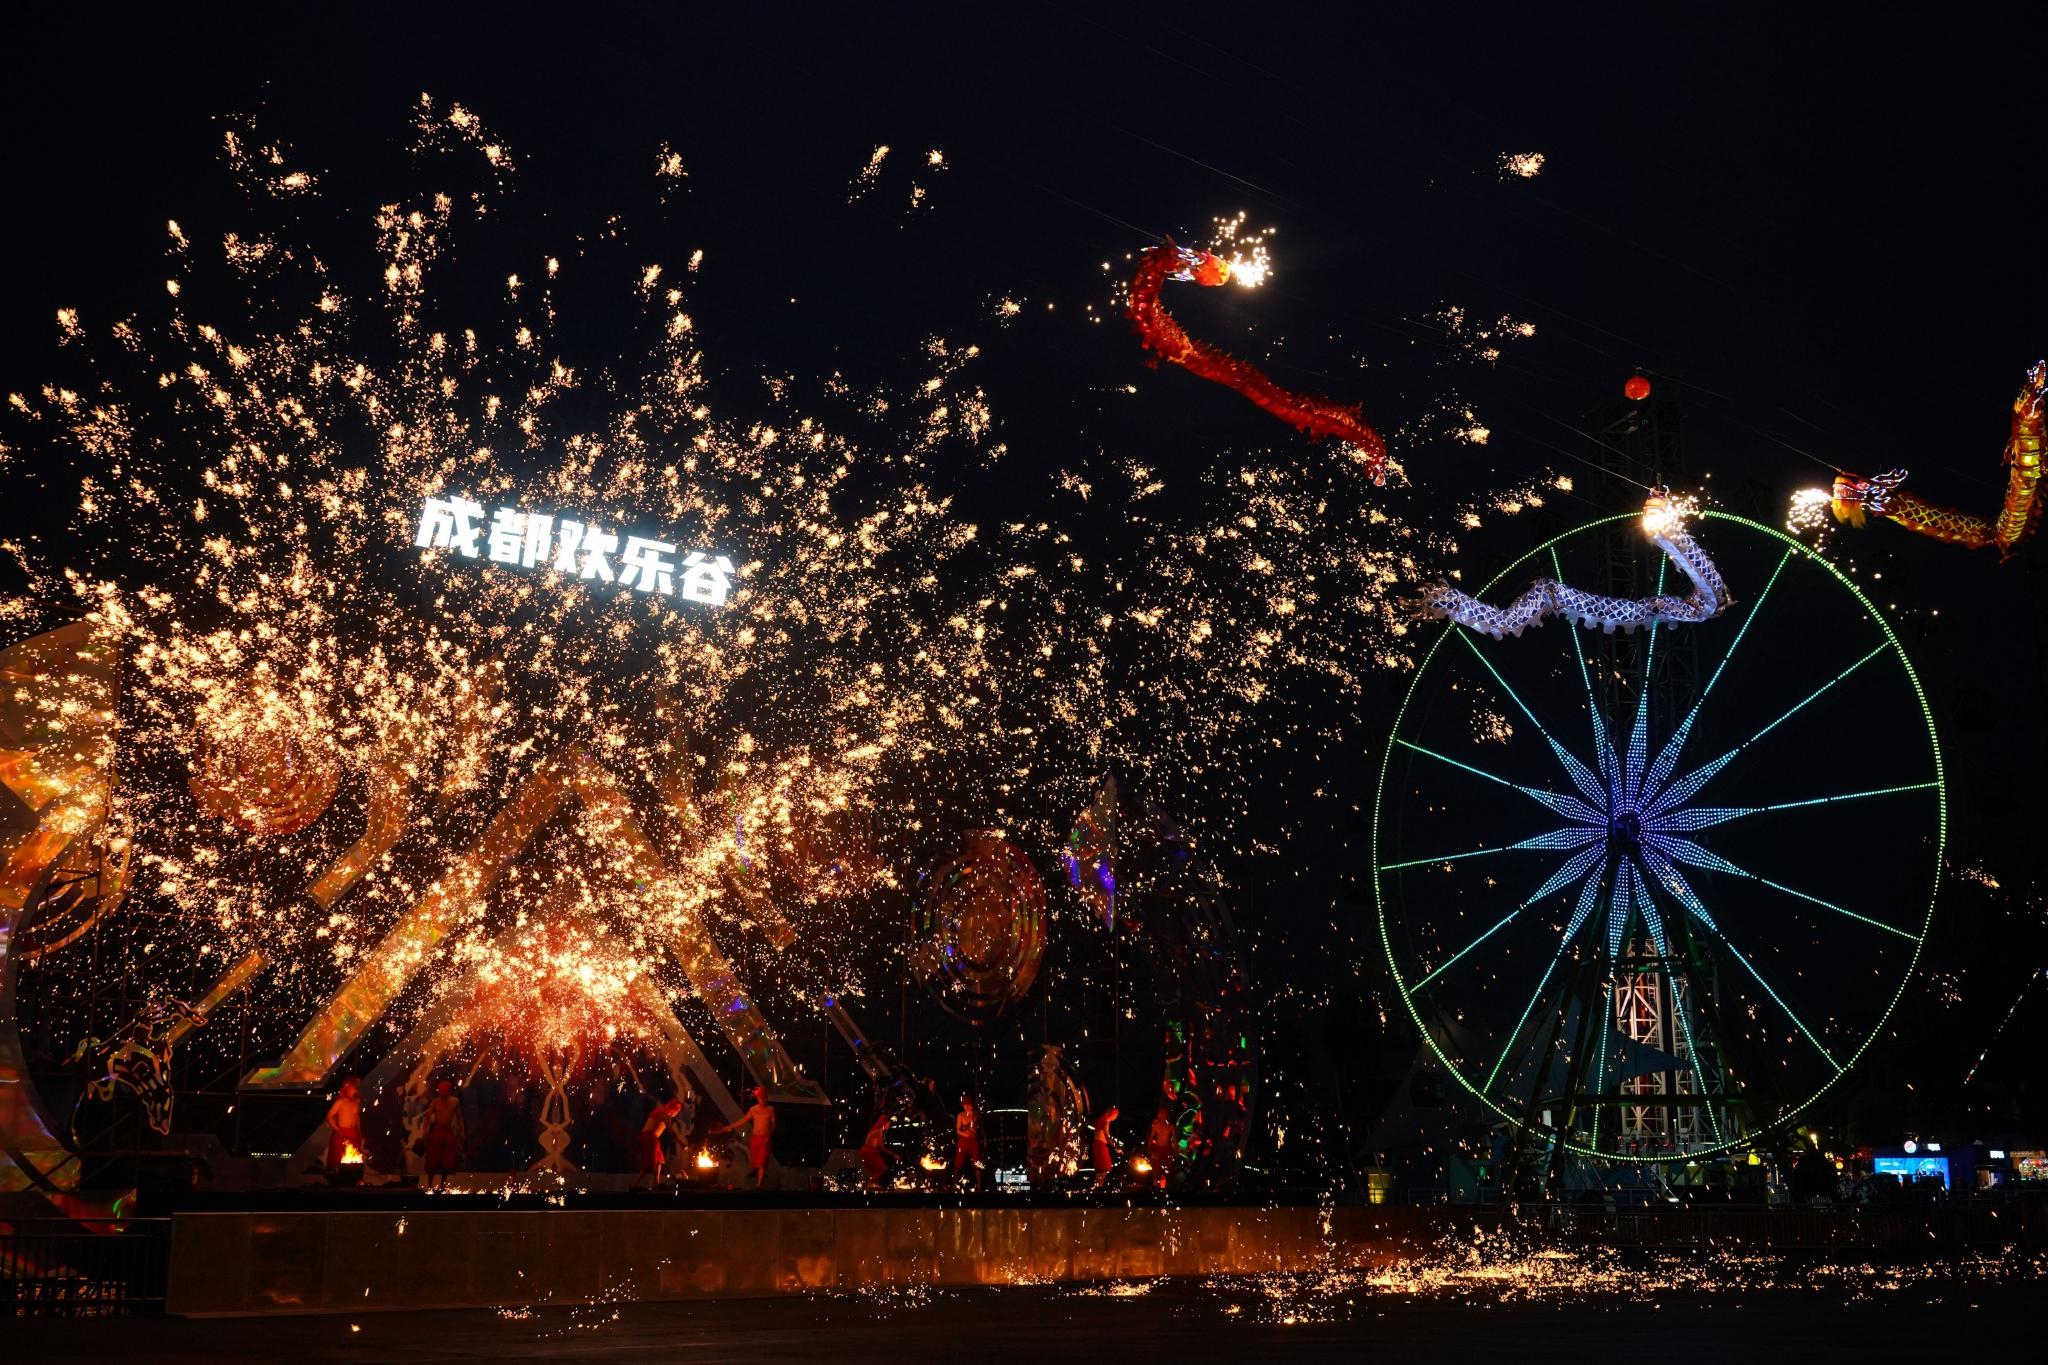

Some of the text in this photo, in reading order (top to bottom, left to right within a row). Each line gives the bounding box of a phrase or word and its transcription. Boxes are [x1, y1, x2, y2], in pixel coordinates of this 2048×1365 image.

[415, 495, 735, 606] 成都欢乐谷
